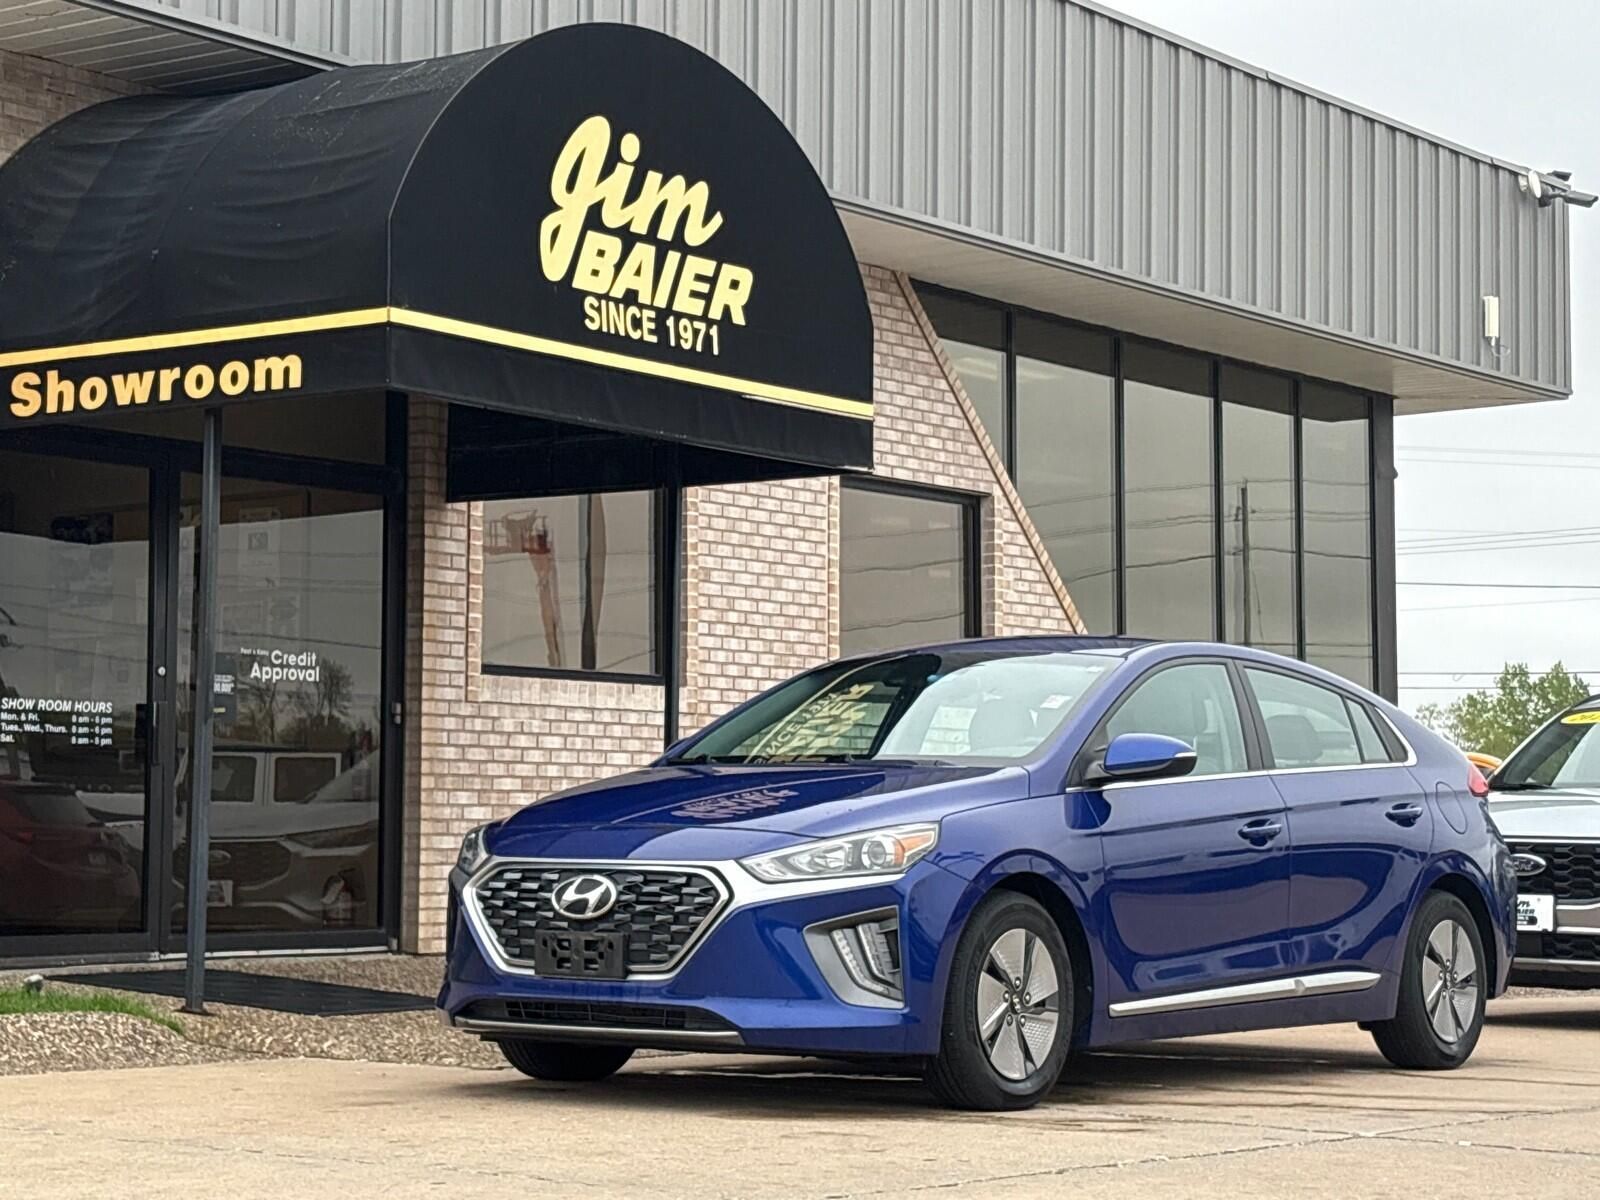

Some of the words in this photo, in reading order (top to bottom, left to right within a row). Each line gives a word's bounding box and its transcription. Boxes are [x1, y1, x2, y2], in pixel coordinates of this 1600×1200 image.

[540, 115, 723, 282] Jim
[571, 230, 753, 326] BAIER
[584, 296, 658, 343] SINCE
[666, 315, 719, 355] 1971
[10, 354, 302, 418] Showroom
[250, 662, 320, 683] Approval
[271, 649, 317, 666] Credit
[1, 697, 36, 710] SHOW
[37, 698, 72, 712] ROOM
[74, 701, 113, 713] HOURS
